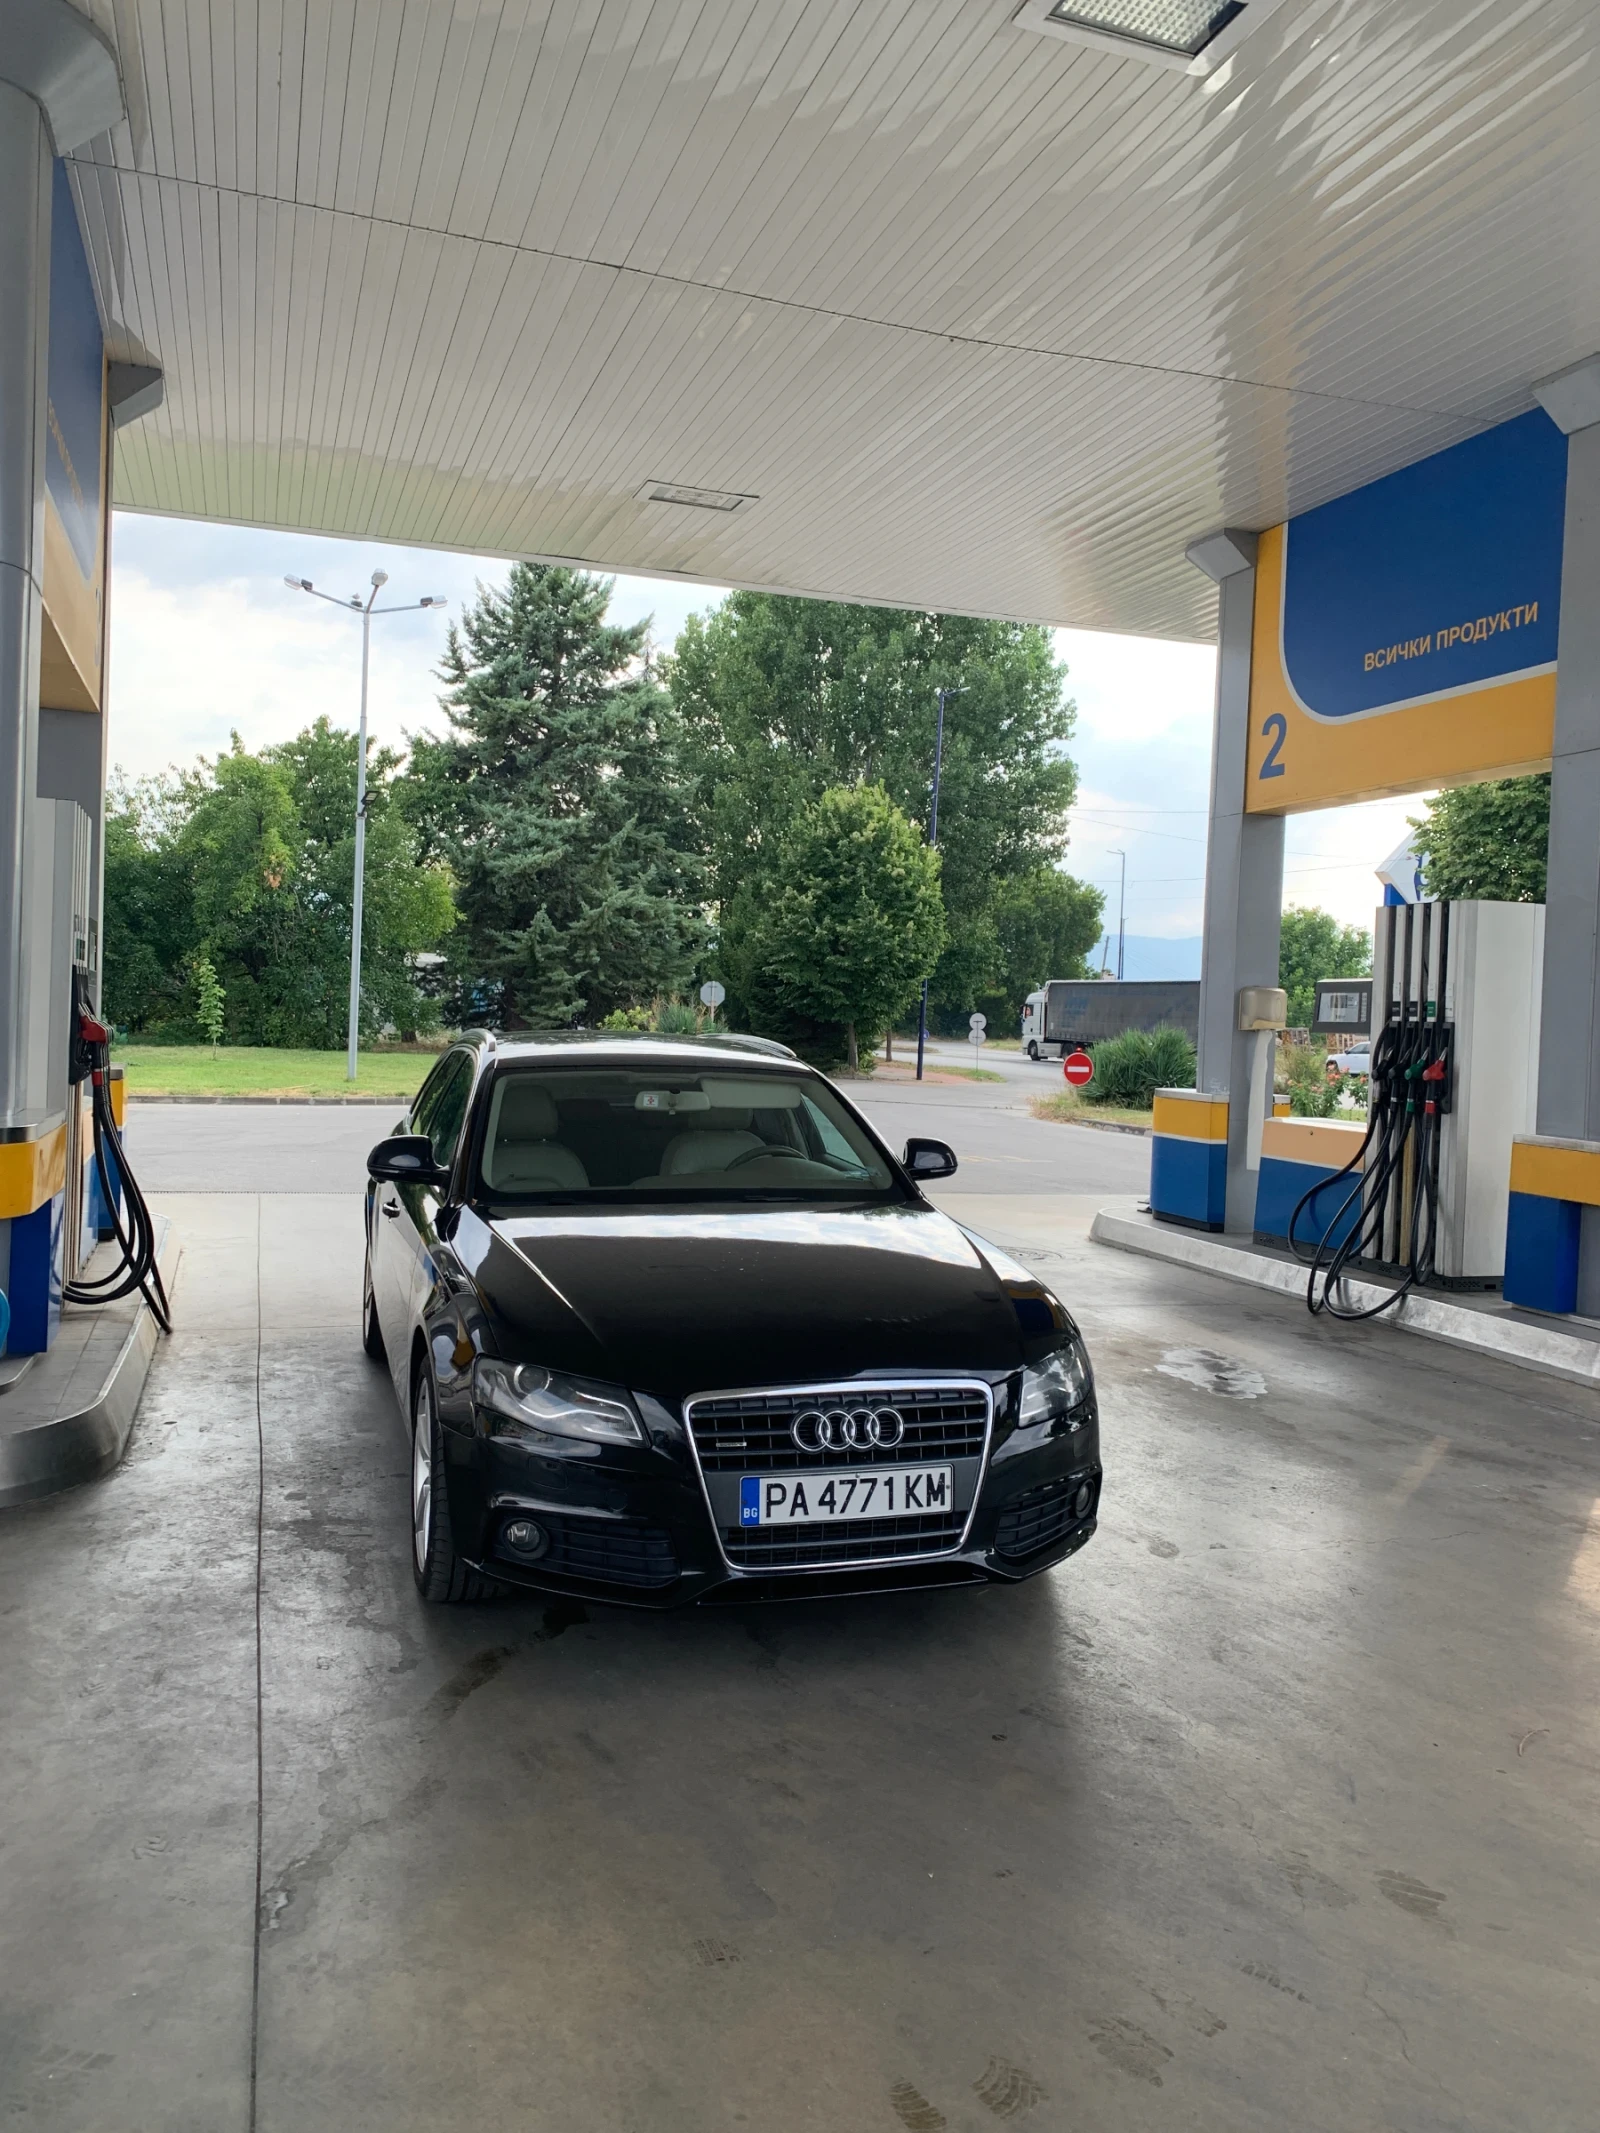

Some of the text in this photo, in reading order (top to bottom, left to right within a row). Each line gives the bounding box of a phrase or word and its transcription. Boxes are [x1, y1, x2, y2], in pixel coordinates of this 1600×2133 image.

[1364, 601, 1539, 672] ВСИЧКИ ПРОДУКТИ
[1259, 712, 1287, 780] 2
[743, 1507, 758, 1519] BG
[765, 1472, 946, 1518] PA 4771 KM
